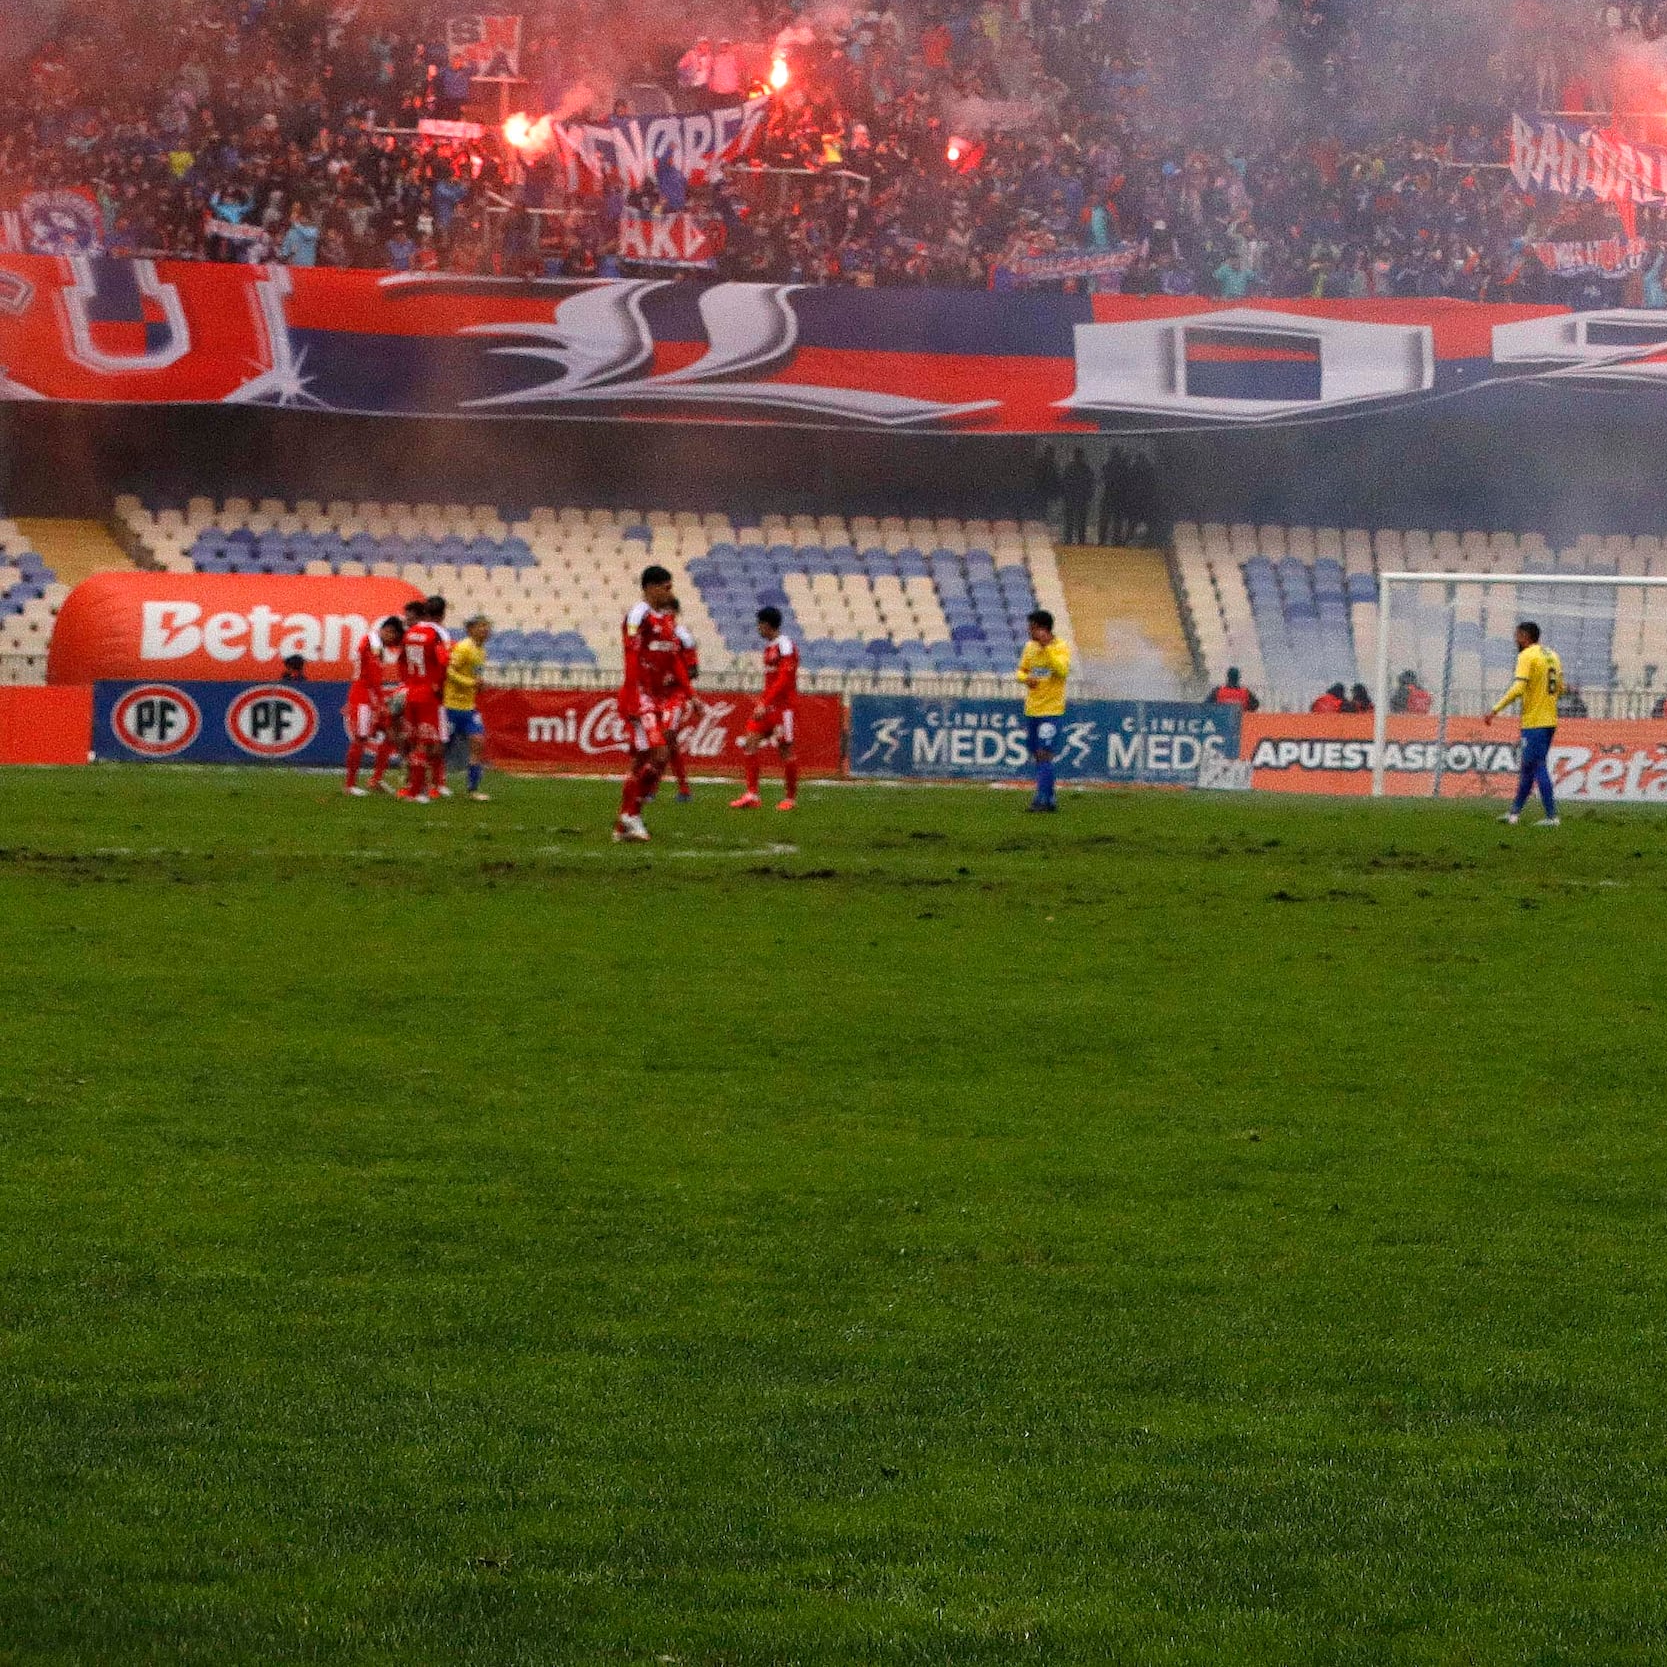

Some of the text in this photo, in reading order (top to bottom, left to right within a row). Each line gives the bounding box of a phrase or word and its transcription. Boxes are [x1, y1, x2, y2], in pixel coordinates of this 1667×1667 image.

[136, 700, 178, 739] PF
[251, 701, 294, 740] PF
[527, 708, 578, 743] mi
[911, 729, 1031, 766] MEDS
[1105, 734, 1245, 770] MEDS
[1254, 741, 1520, 771] APUESTASROYA
